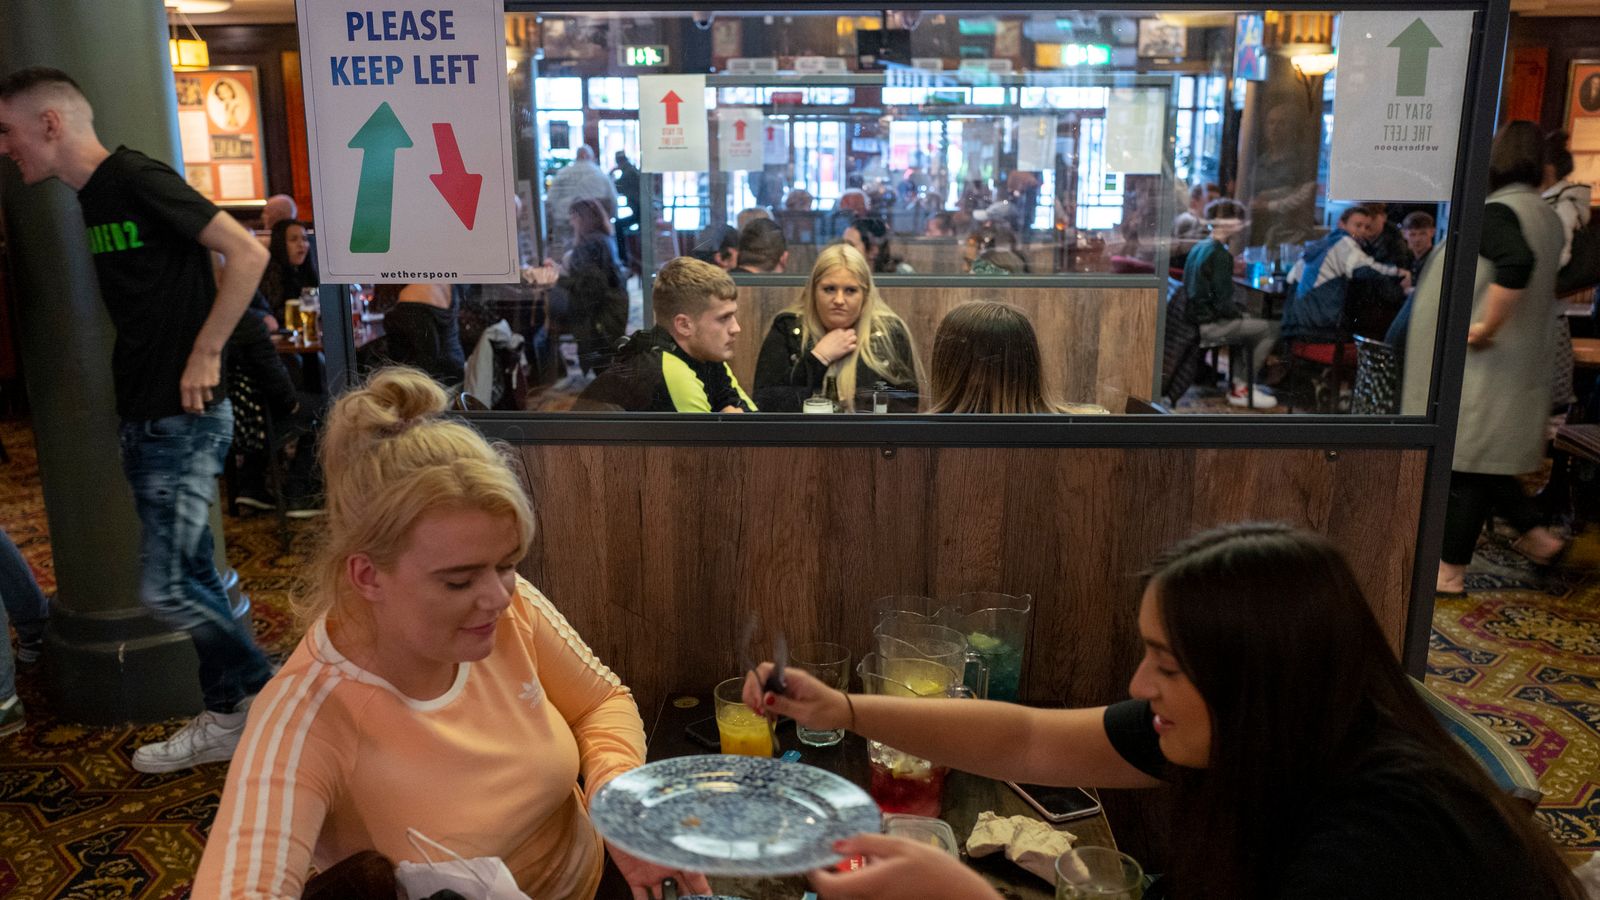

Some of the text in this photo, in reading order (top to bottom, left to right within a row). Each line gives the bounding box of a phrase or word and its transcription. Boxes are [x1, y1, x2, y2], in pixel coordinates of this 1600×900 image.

[346, 9, 456, 42] PLEASE
[330, 54, 480, 86] KEEP LEFT
[380, 270, 458, 280] wetherspoon
